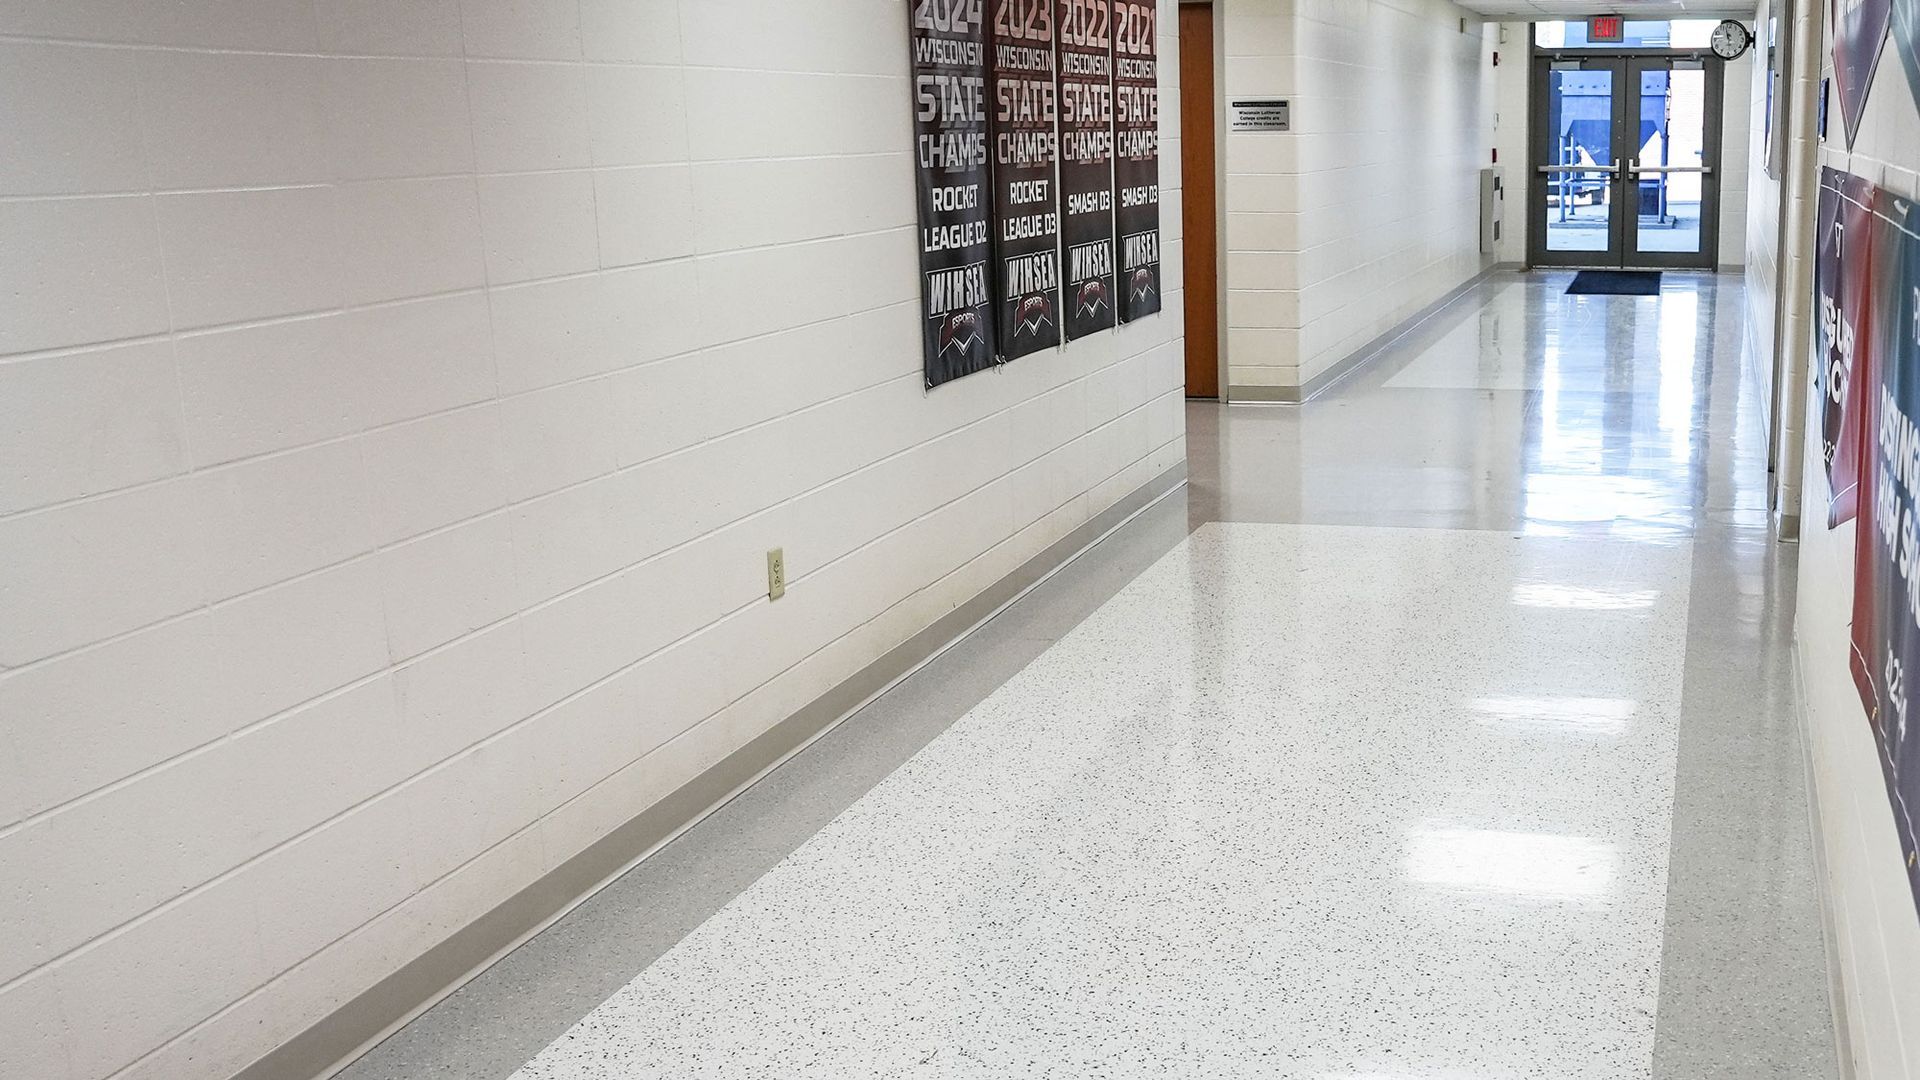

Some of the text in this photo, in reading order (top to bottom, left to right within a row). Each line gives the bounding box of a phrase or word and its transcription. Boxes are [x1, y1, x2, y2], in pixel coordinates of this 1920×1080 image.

[914, 0, 983, 34] 2024
[994, 0, 1052, 42] 2023
[1060, 0, 1109, 49] 2022
[1115, 2, 1157, 55] 2021
[1594, 18, 1617, 38] EXIT
[915, 38, 984, 66] WISCONSIN
[996, 45, 1053, 72] WISCONSIN
[1062, 52, 1110, 76] WISCONSIN
[1116, 58, 1157, 80] WISCONSIN
[916, 74, 985, 123] STATE
[997, 79, 1054, 122] STATE
[1063, 82, 1110, 123] STATE
[1117, 85, 1158, 123] STATE
[919, 131, 986, 169] CHAMPS
[997, 131, 1055, 165] CHAMPS
[1063, 131, 1111, 161] CHAMPS
[1118, 130, 1158, 159] CHAMPS
[932, 184, 979, 212] ROCKET
[1010, 180, 1049, 204] ROCKET
[1068, 190, 1110, 215] SMASH D3
[1122, 183, 1158, 208] SMASH D3
[924, 220, 987, 252] LEAGUE D2
[1003, 212, 1056, 241] LEAGUE D3
[1084, 281, 1100, 293] ESPORTS
[1024, 295, 1044, 312] ESPORTS
[951, 311, 976, 330] ESPORTS
